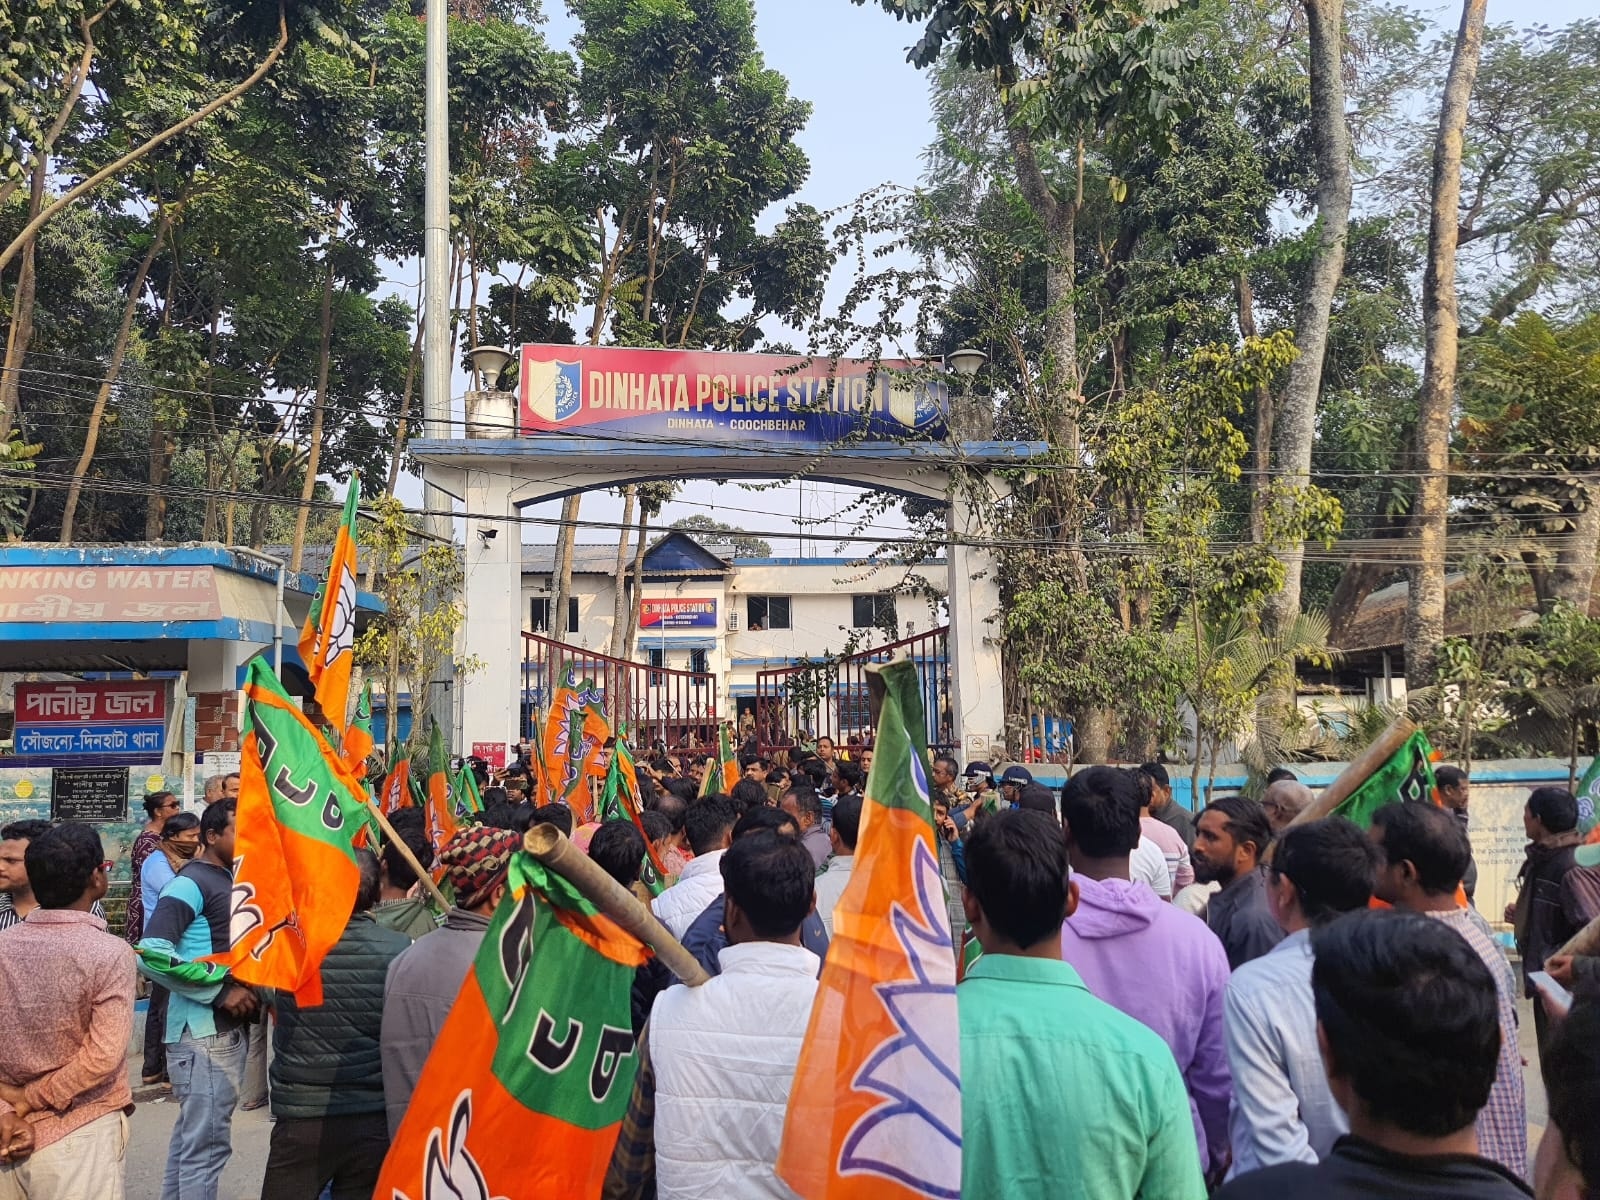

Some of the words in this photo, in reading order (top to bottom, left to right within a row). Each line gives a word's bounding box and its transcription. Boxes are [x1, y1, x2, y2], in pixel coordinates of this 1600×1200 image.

[589, 370, 690, 412] DINHATA
[696, 373, 780, 412] POLICE
[786, 376, 884, 413] STATION
[667, 417, 714, 429] DINHATA
[730, 419, 806, 431] COOCHBEHAR
[107, 570, 211, 589] WATER
[0, 594, 105, 619] ানীয়
[121, 602, 212, 617] জল
[26, 686, 97, 720] পানীয়
[104, 690, 156, 714] জল
[132, 731, 160, 749] থানা
